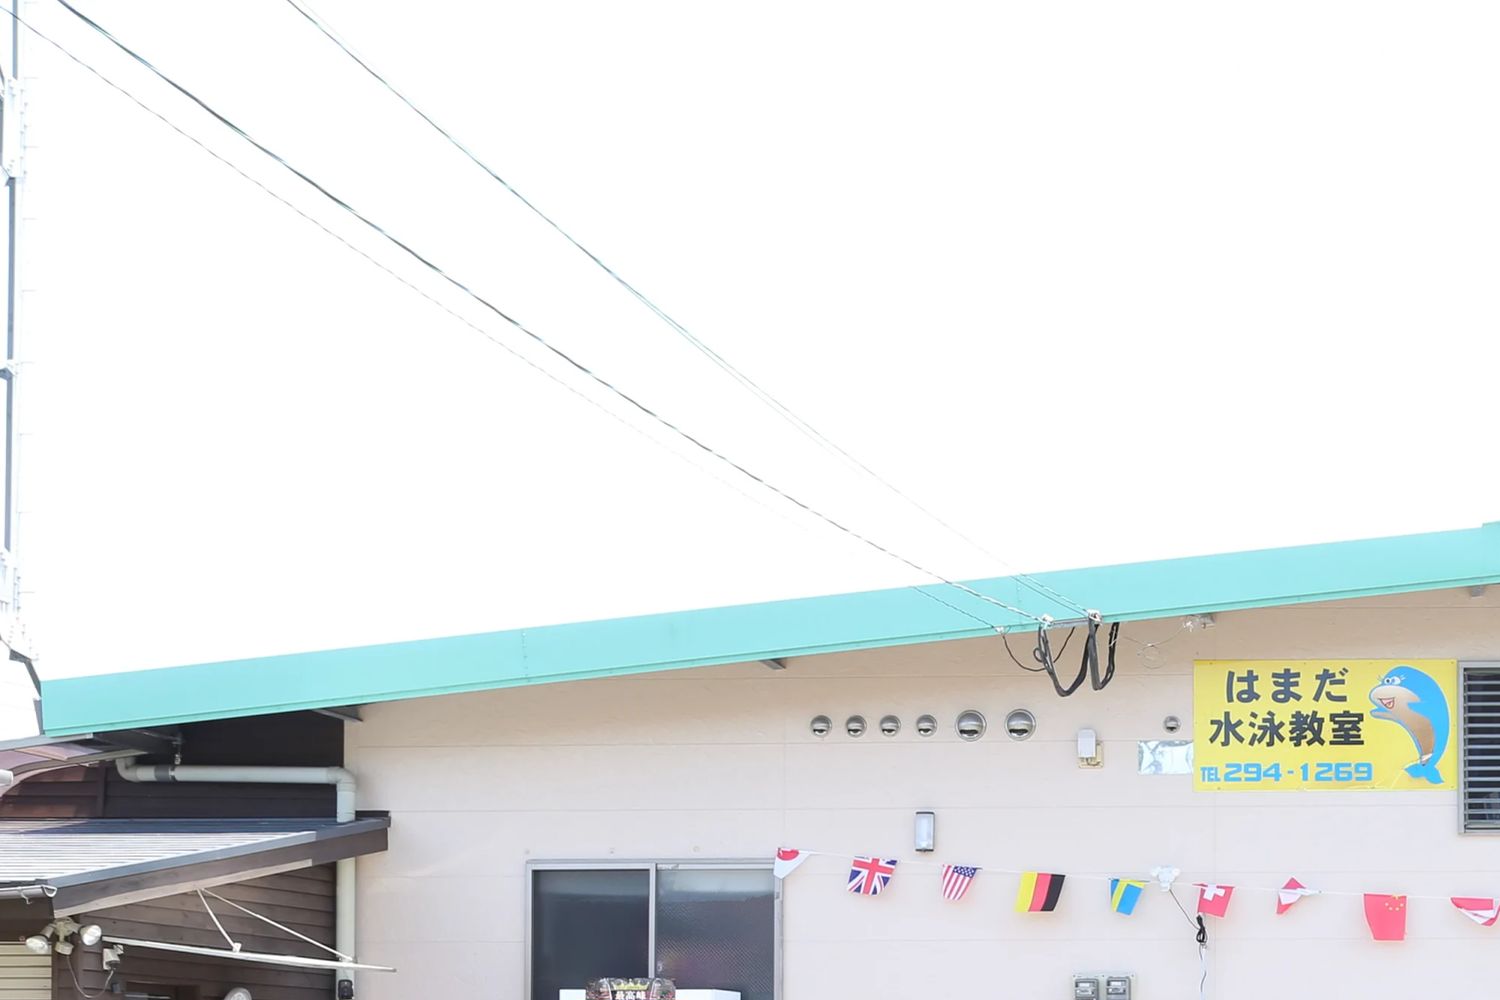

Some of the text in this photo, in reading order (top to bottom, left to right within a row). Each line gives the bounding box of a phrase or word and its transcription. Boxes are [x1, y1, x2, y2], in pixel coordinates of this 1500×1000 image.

[1227, 668, 1348, 703] はまだ
[1209, 711, 1364, 747] 水泳教室
[1200, 763, 1372, 782] TEL 294-1269
